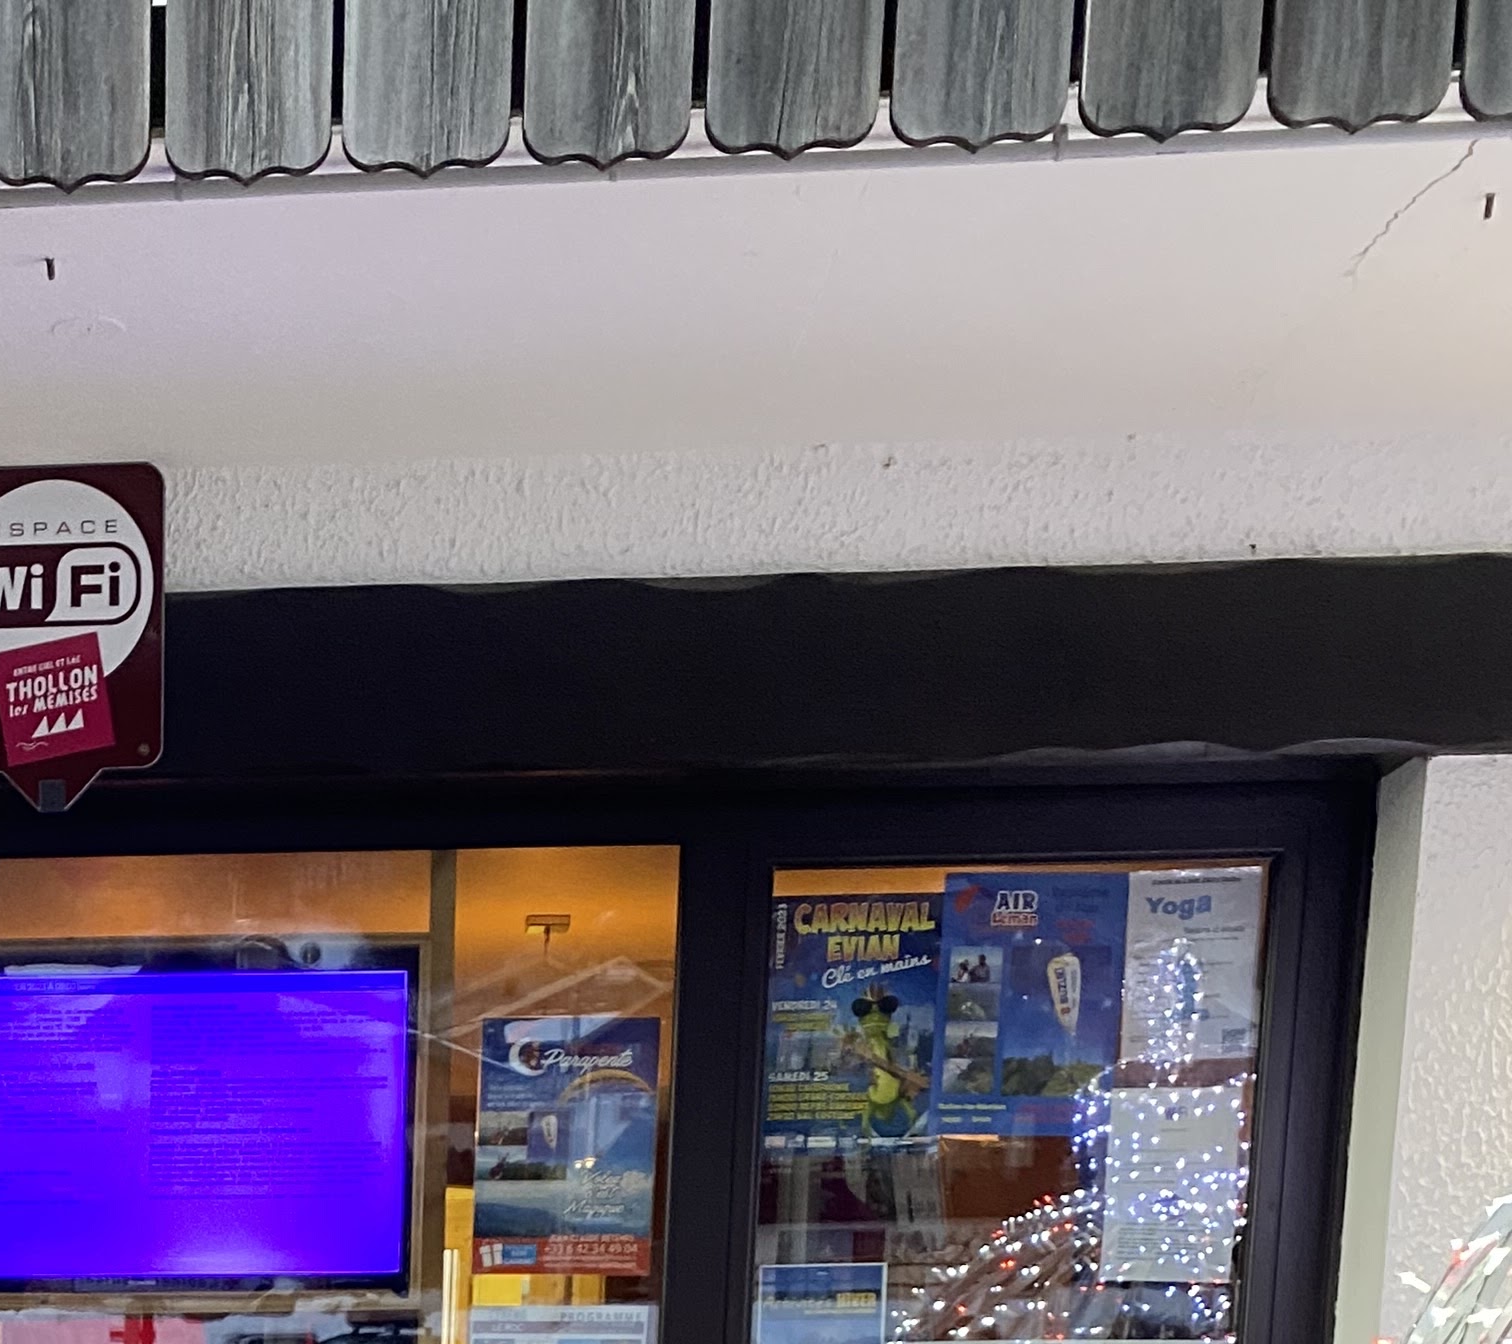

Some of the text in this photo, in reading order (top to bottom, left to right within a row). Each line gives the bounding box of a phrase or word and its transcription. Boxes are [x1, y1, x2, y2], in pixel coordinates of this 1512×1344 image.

[6, 664, 98, 703] THOLLON
[9, 704, 29, 718] les
[996, 890, 1038, 911] AIR
[1145, 895, 1213, 920] Yoga
[793, 901, 936, 935] CARNAVAL
[827, 934, 901, 962] EVIAN
[821, 964, 854, 988] Clé
[857, 967, 879, 979] en
[540, 1047, 633, 1075] Parapente
[768, 1071, 829, 1081] SAMEDI 25
